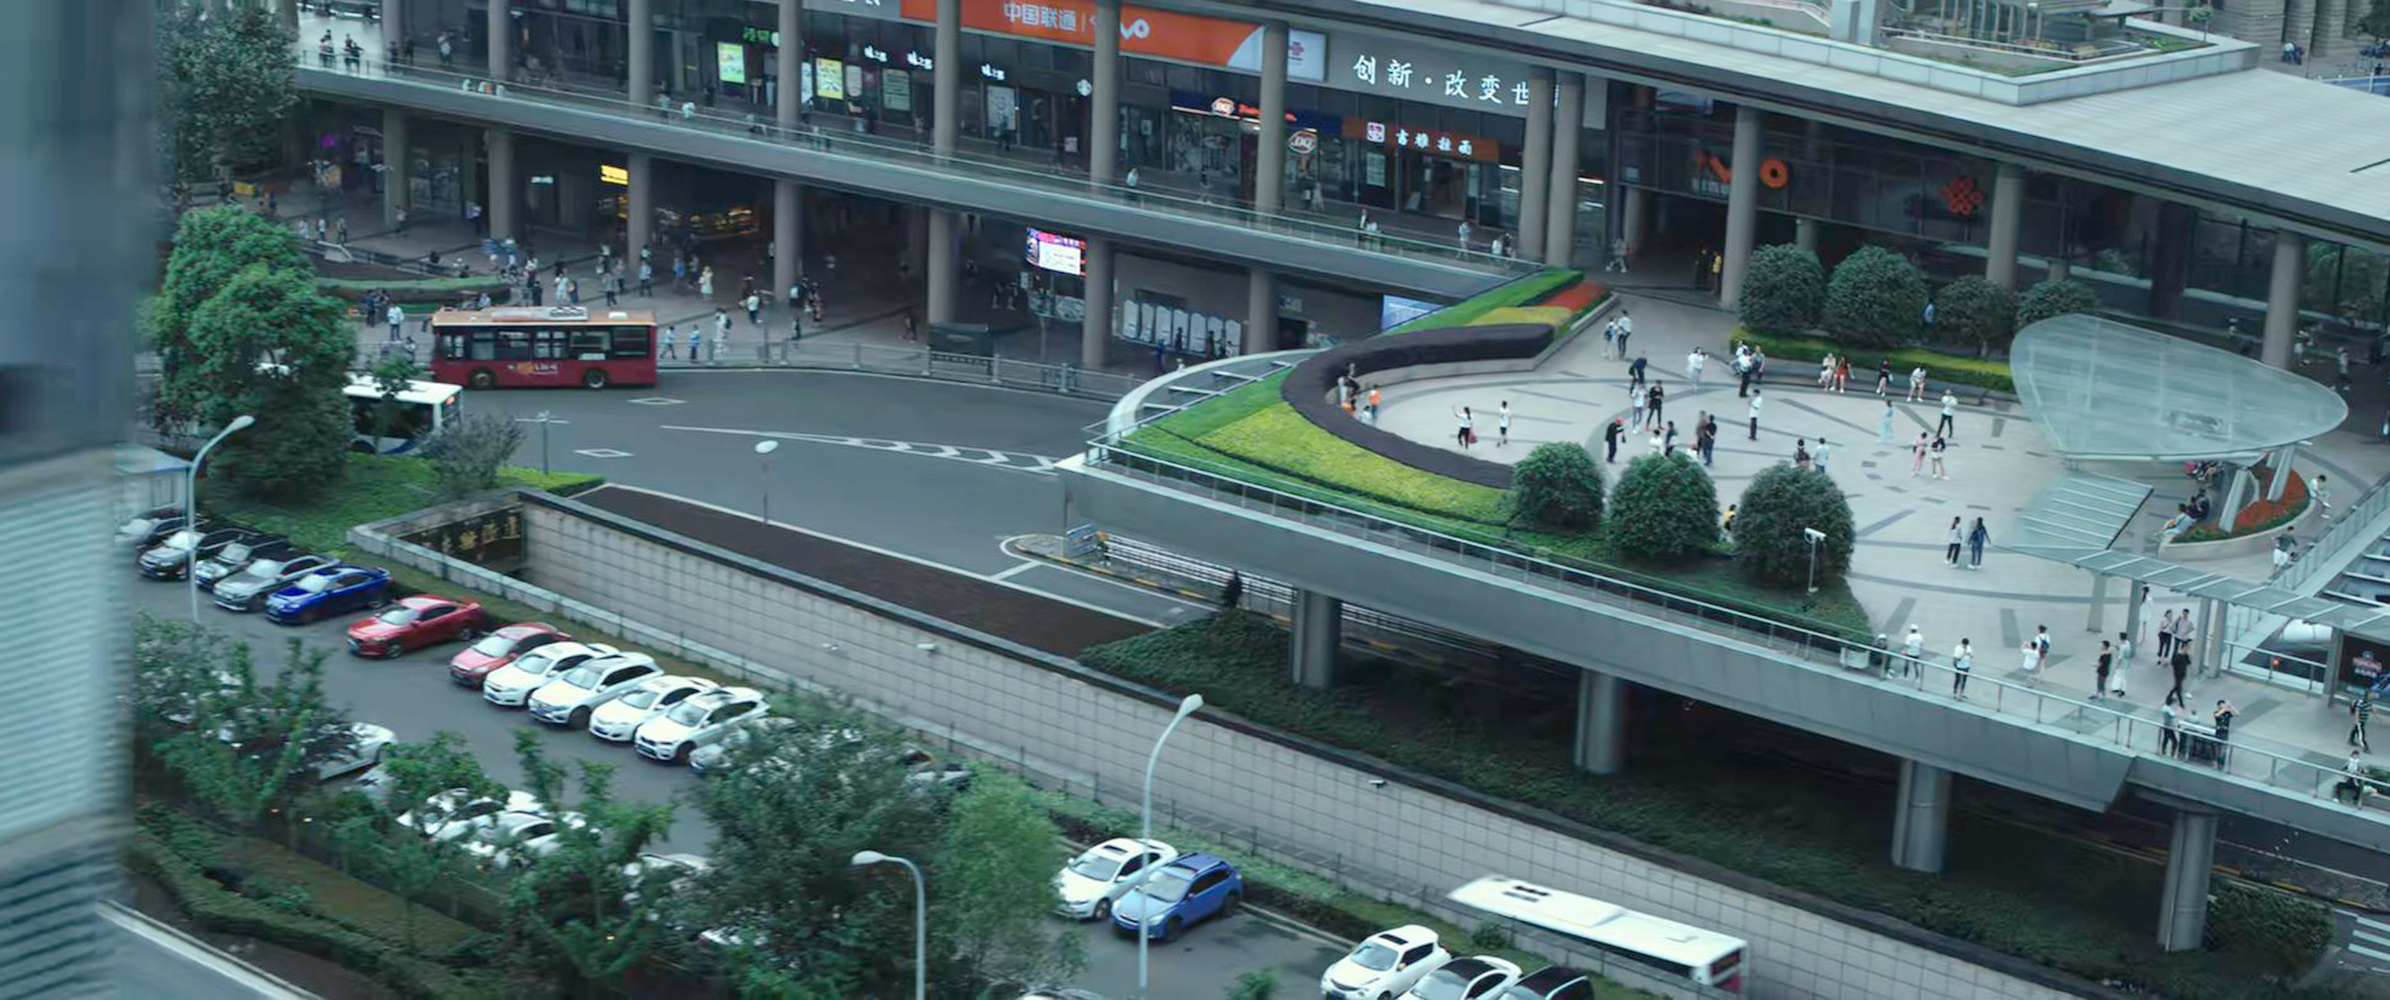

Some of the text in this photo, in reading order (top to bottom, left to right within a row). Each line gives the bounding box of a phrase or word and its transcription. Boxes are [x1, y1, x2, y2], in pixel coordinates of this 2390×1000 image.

[1004, 3, 1076, 31] 中国联通
[1353, 54, 1560, 107] 创新·改变世
